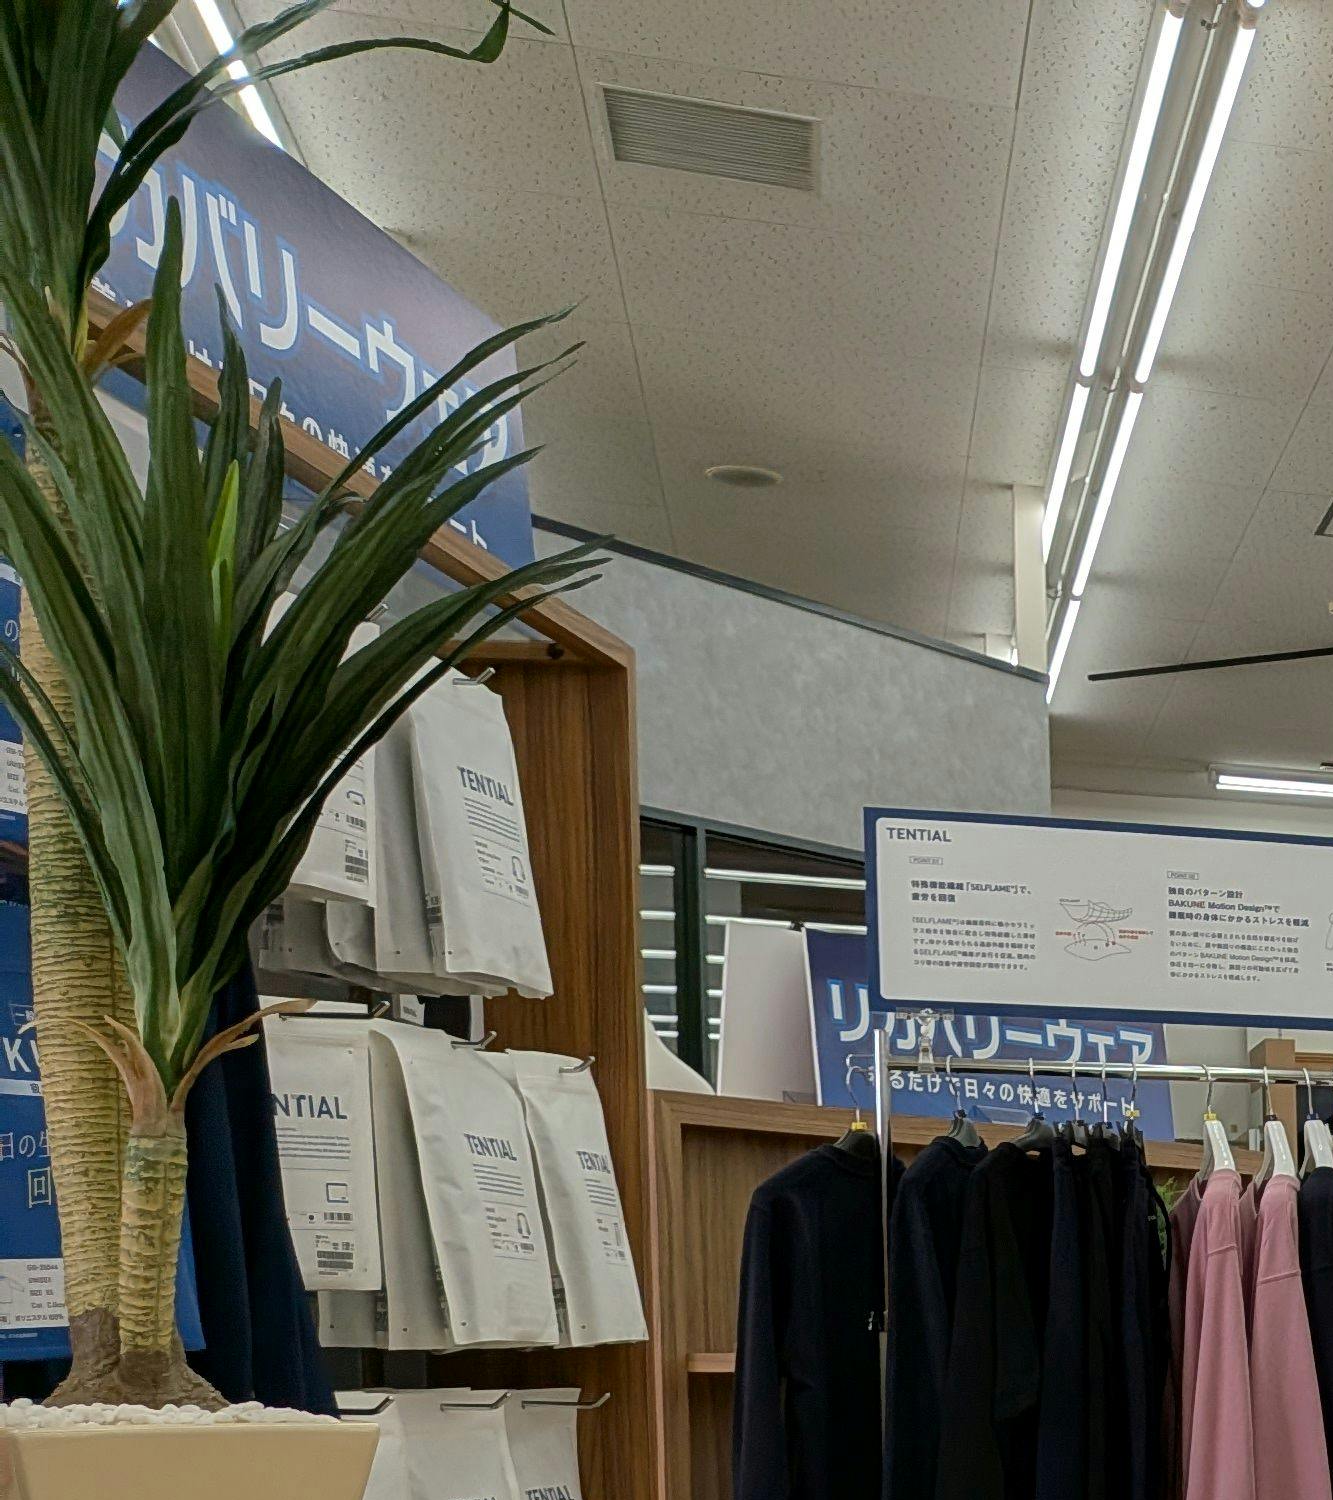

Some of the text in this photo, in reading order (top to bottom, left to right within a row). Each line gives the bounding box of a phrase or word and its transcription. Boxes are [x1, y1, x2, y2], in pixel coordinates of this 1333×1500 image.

[456, 766, 515, 807] TENTIAL
[886, 827, 952, 842] TENTIAL
[1168, 900, 1205, 908] BAKUNE
[1208, 902, 1235, 910] Motion
[464, 1132, 518, 1162] TENTIAL
